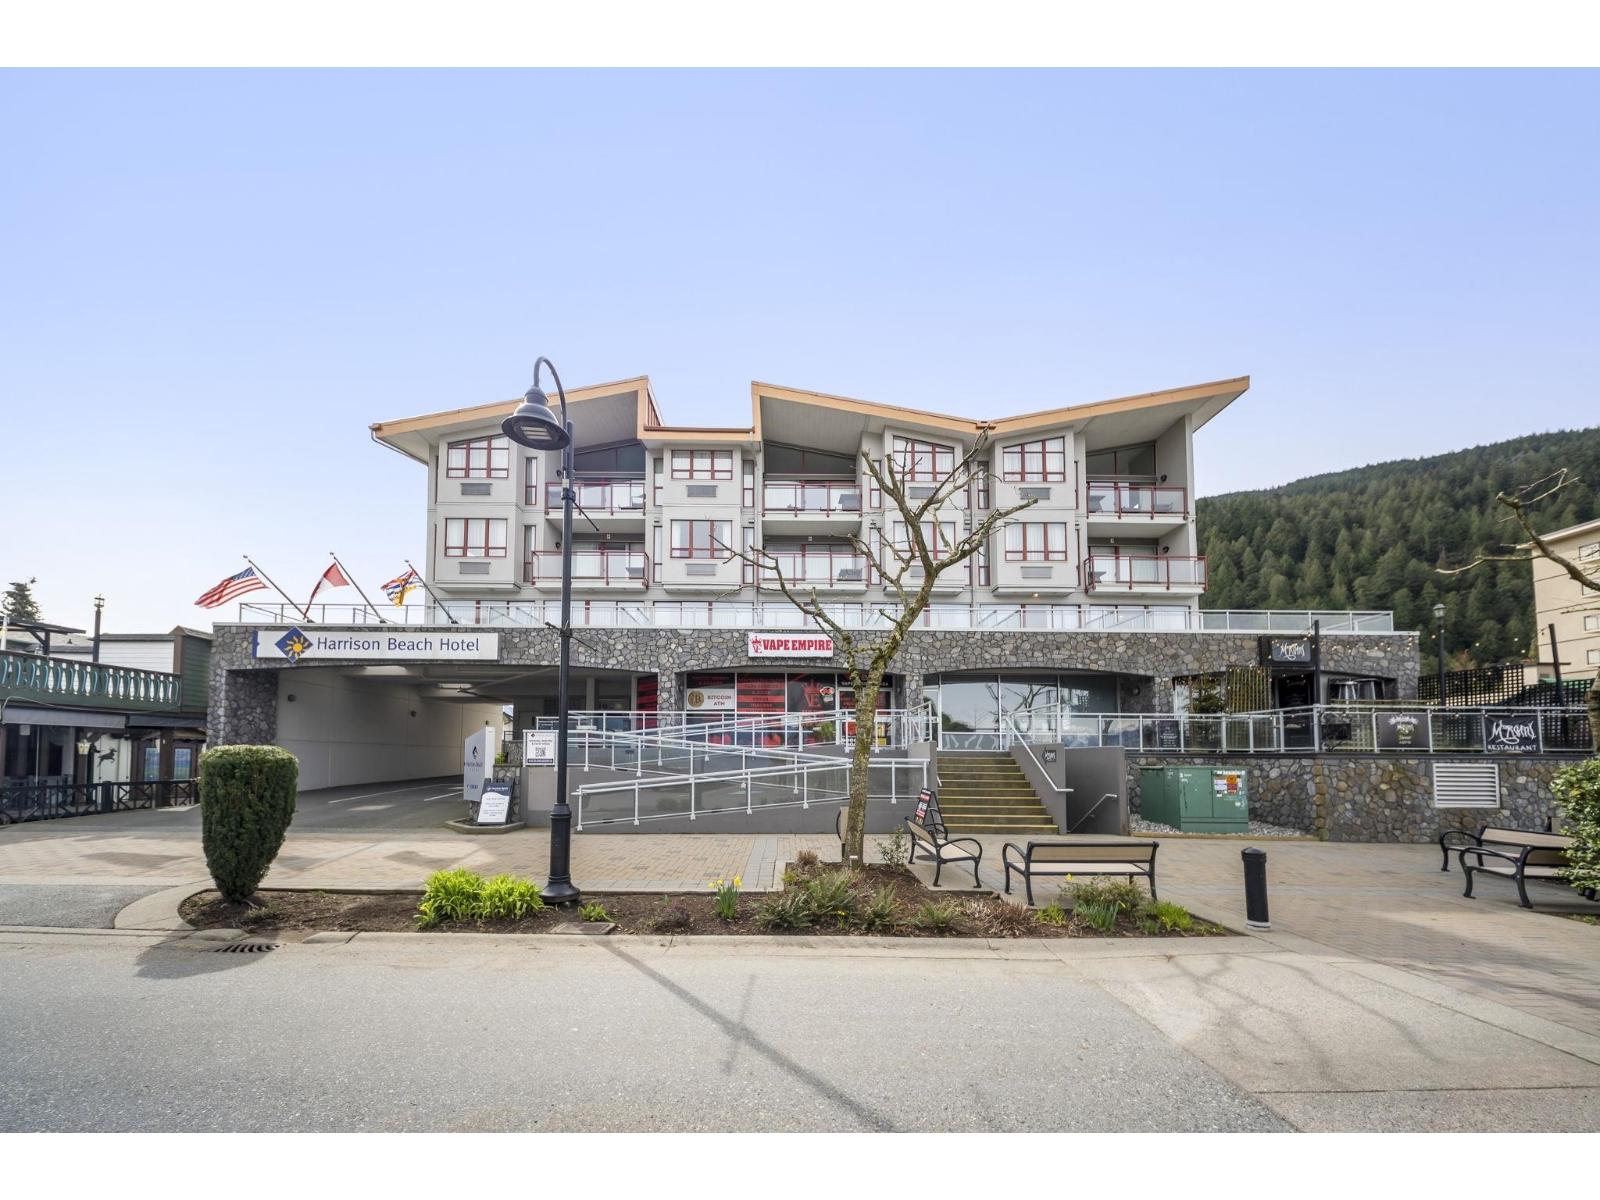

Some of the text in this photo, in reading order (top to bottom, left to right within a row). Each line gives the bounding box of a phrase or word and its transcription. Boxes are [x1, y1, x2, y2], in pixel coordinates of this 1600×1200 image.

[317, 637, 479, 651] Harrison Beach Hotel
[762, 639, 832, 651] VAPE EMPIRE
